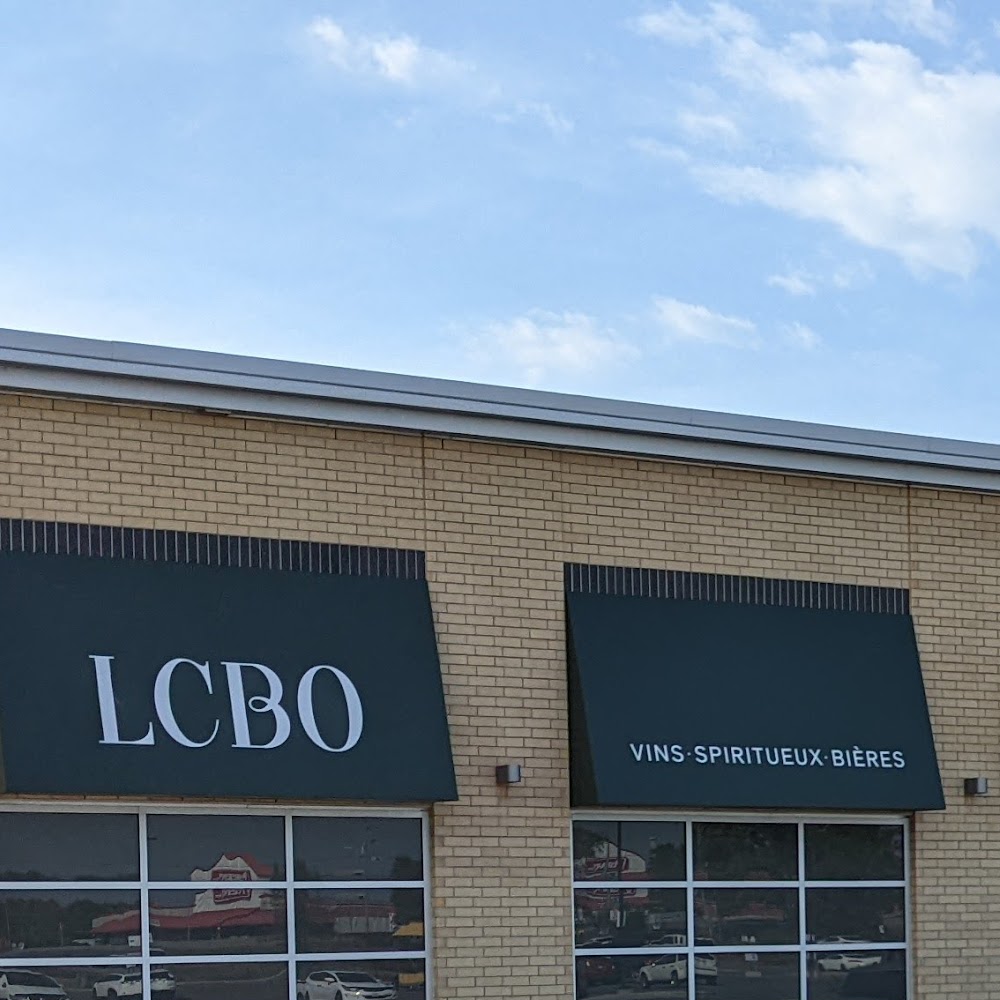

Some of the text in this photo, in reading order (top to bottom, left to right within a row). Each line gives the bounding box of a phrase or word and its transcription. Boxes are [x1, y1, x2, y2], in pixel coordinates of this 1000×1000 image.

[88, 653, 365, 754] LCBO
[629, 743, 906, 769] VINS SPIRITUEUX BIÈRES
